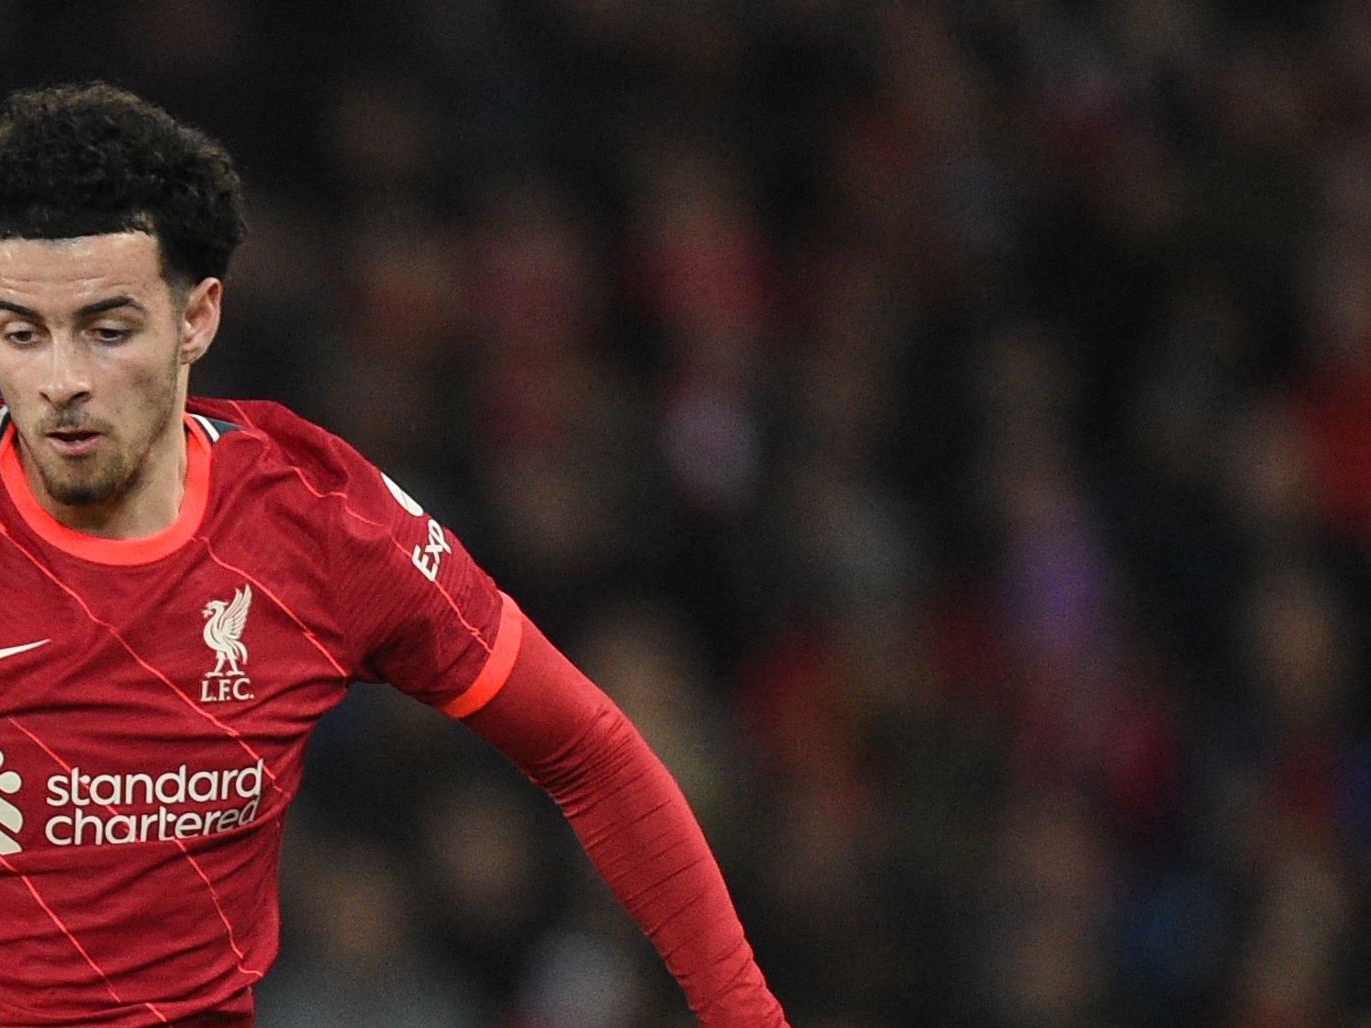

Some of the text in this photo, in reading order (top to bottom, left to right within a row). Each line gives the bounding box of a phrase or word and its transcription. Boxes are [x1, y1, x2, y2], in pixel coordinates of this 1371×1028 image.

[200, 677, 255, 702] L.F.C.
[45, 758, 264, 807] standard
[45, 800, 259, 846] chartered
